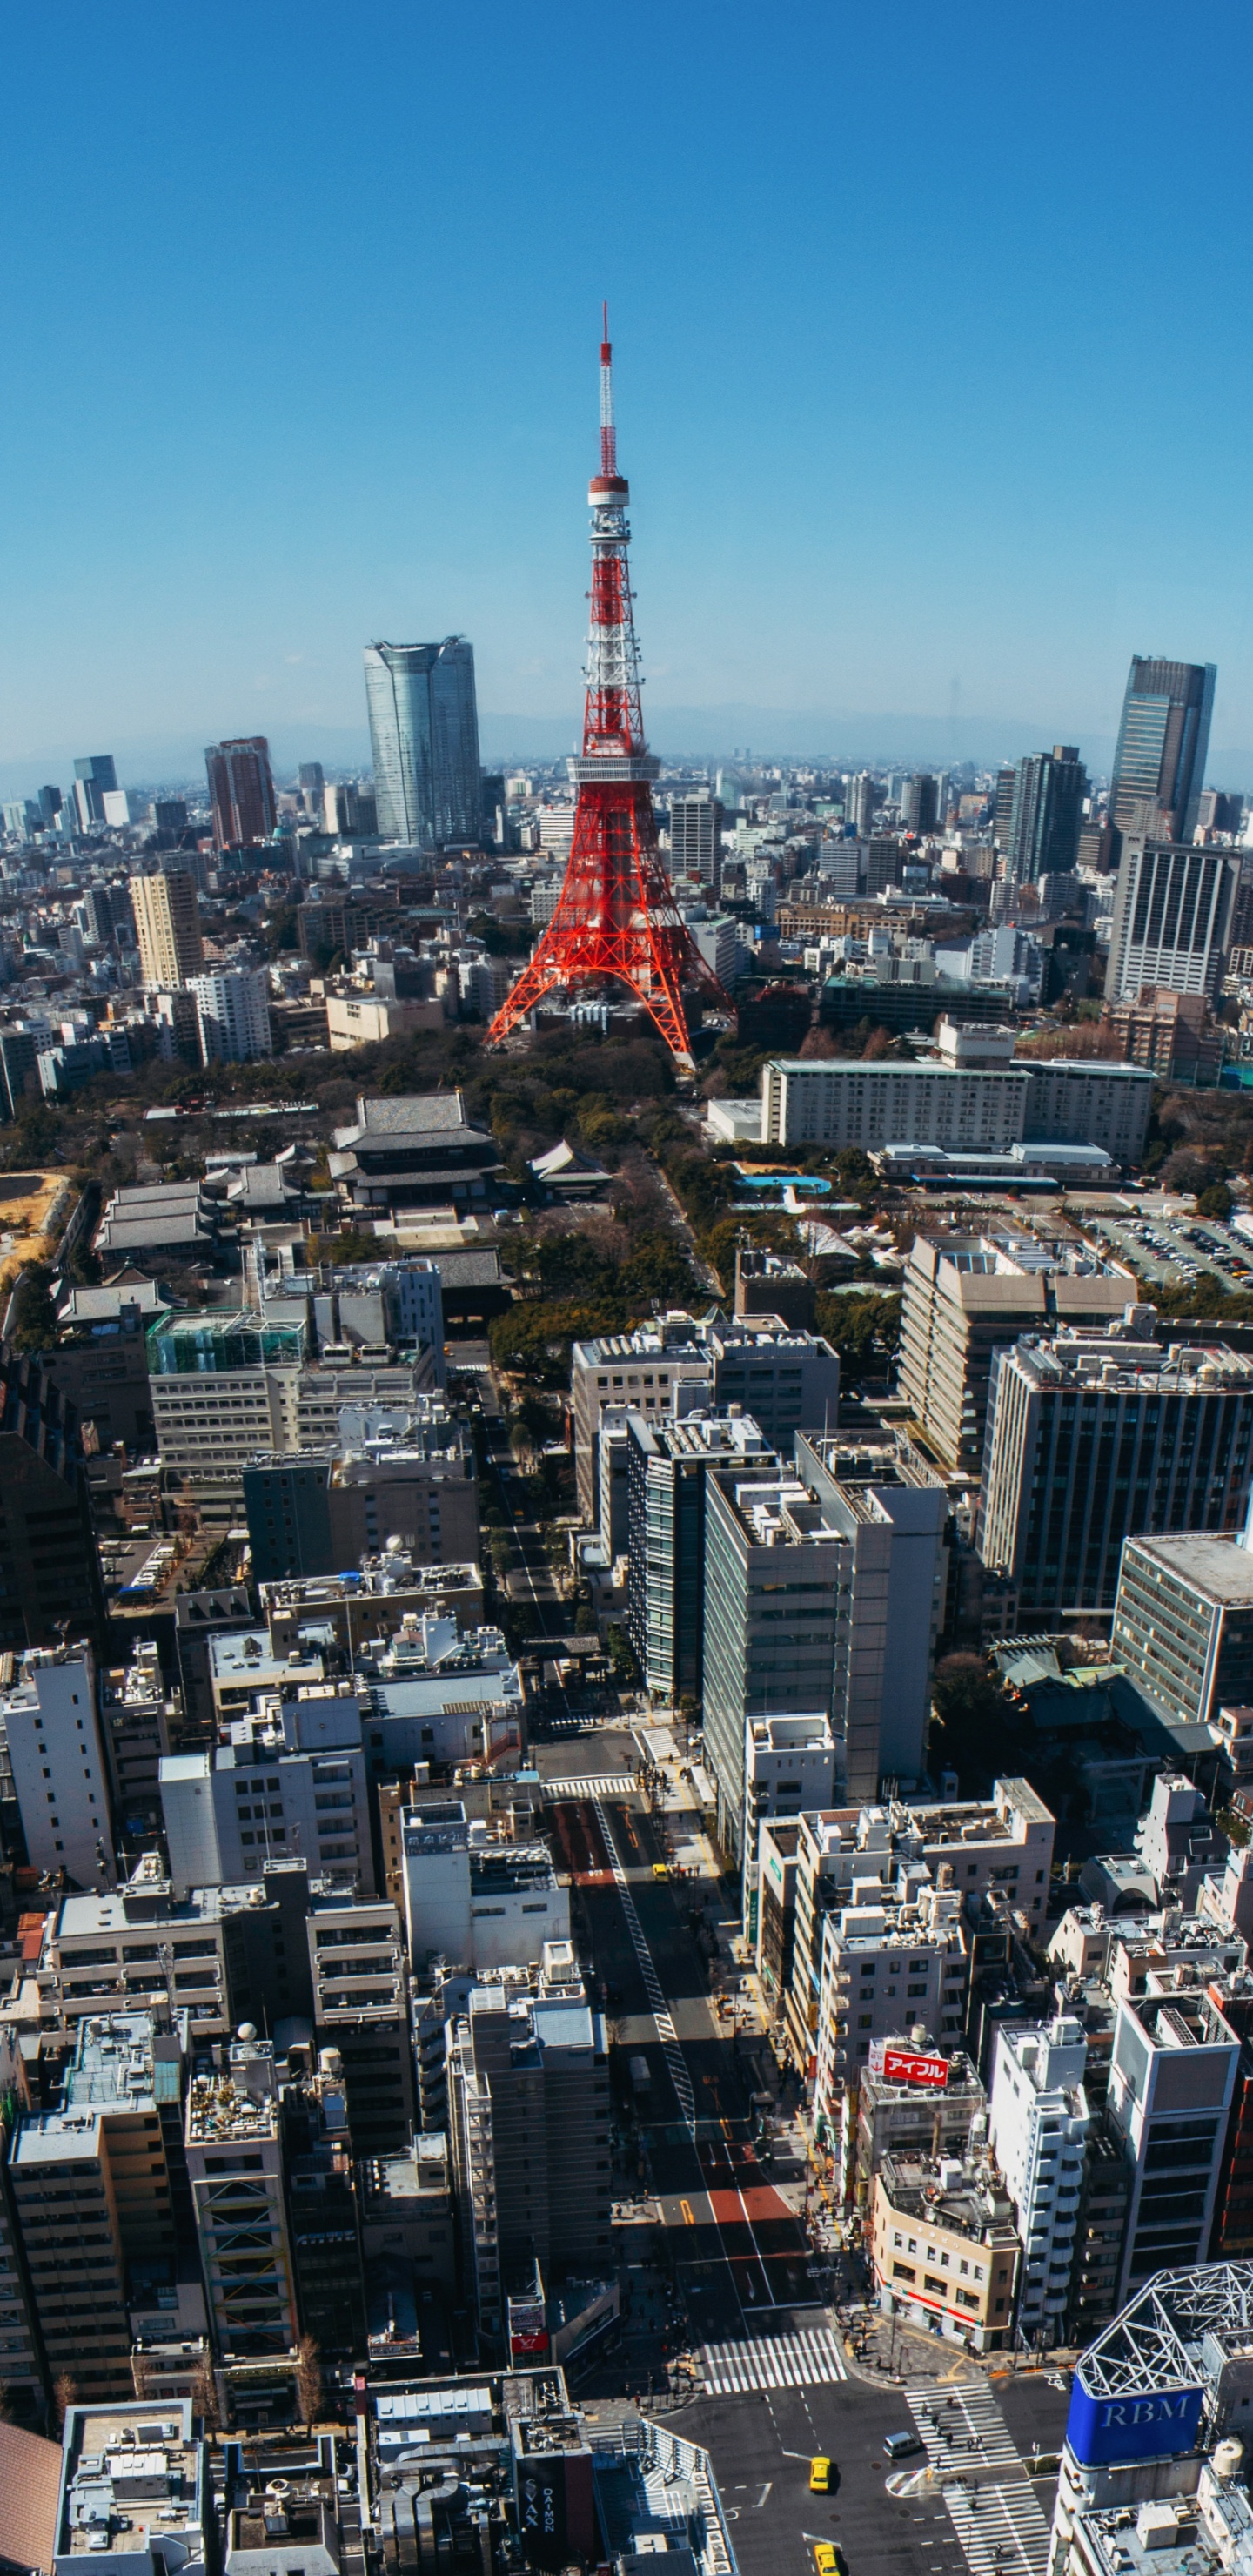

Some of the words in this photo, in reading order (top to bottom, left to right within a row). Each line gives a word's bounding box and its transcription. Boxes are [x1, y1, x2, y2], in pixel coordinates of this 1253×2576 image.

[888, 2056, 946, 2079] アイフル
[1101, 2395, 1190, 2428] RBM
[525, 2479, 539, 2526] SVAX
[543, 2488, 555, 2532] DAIMON
